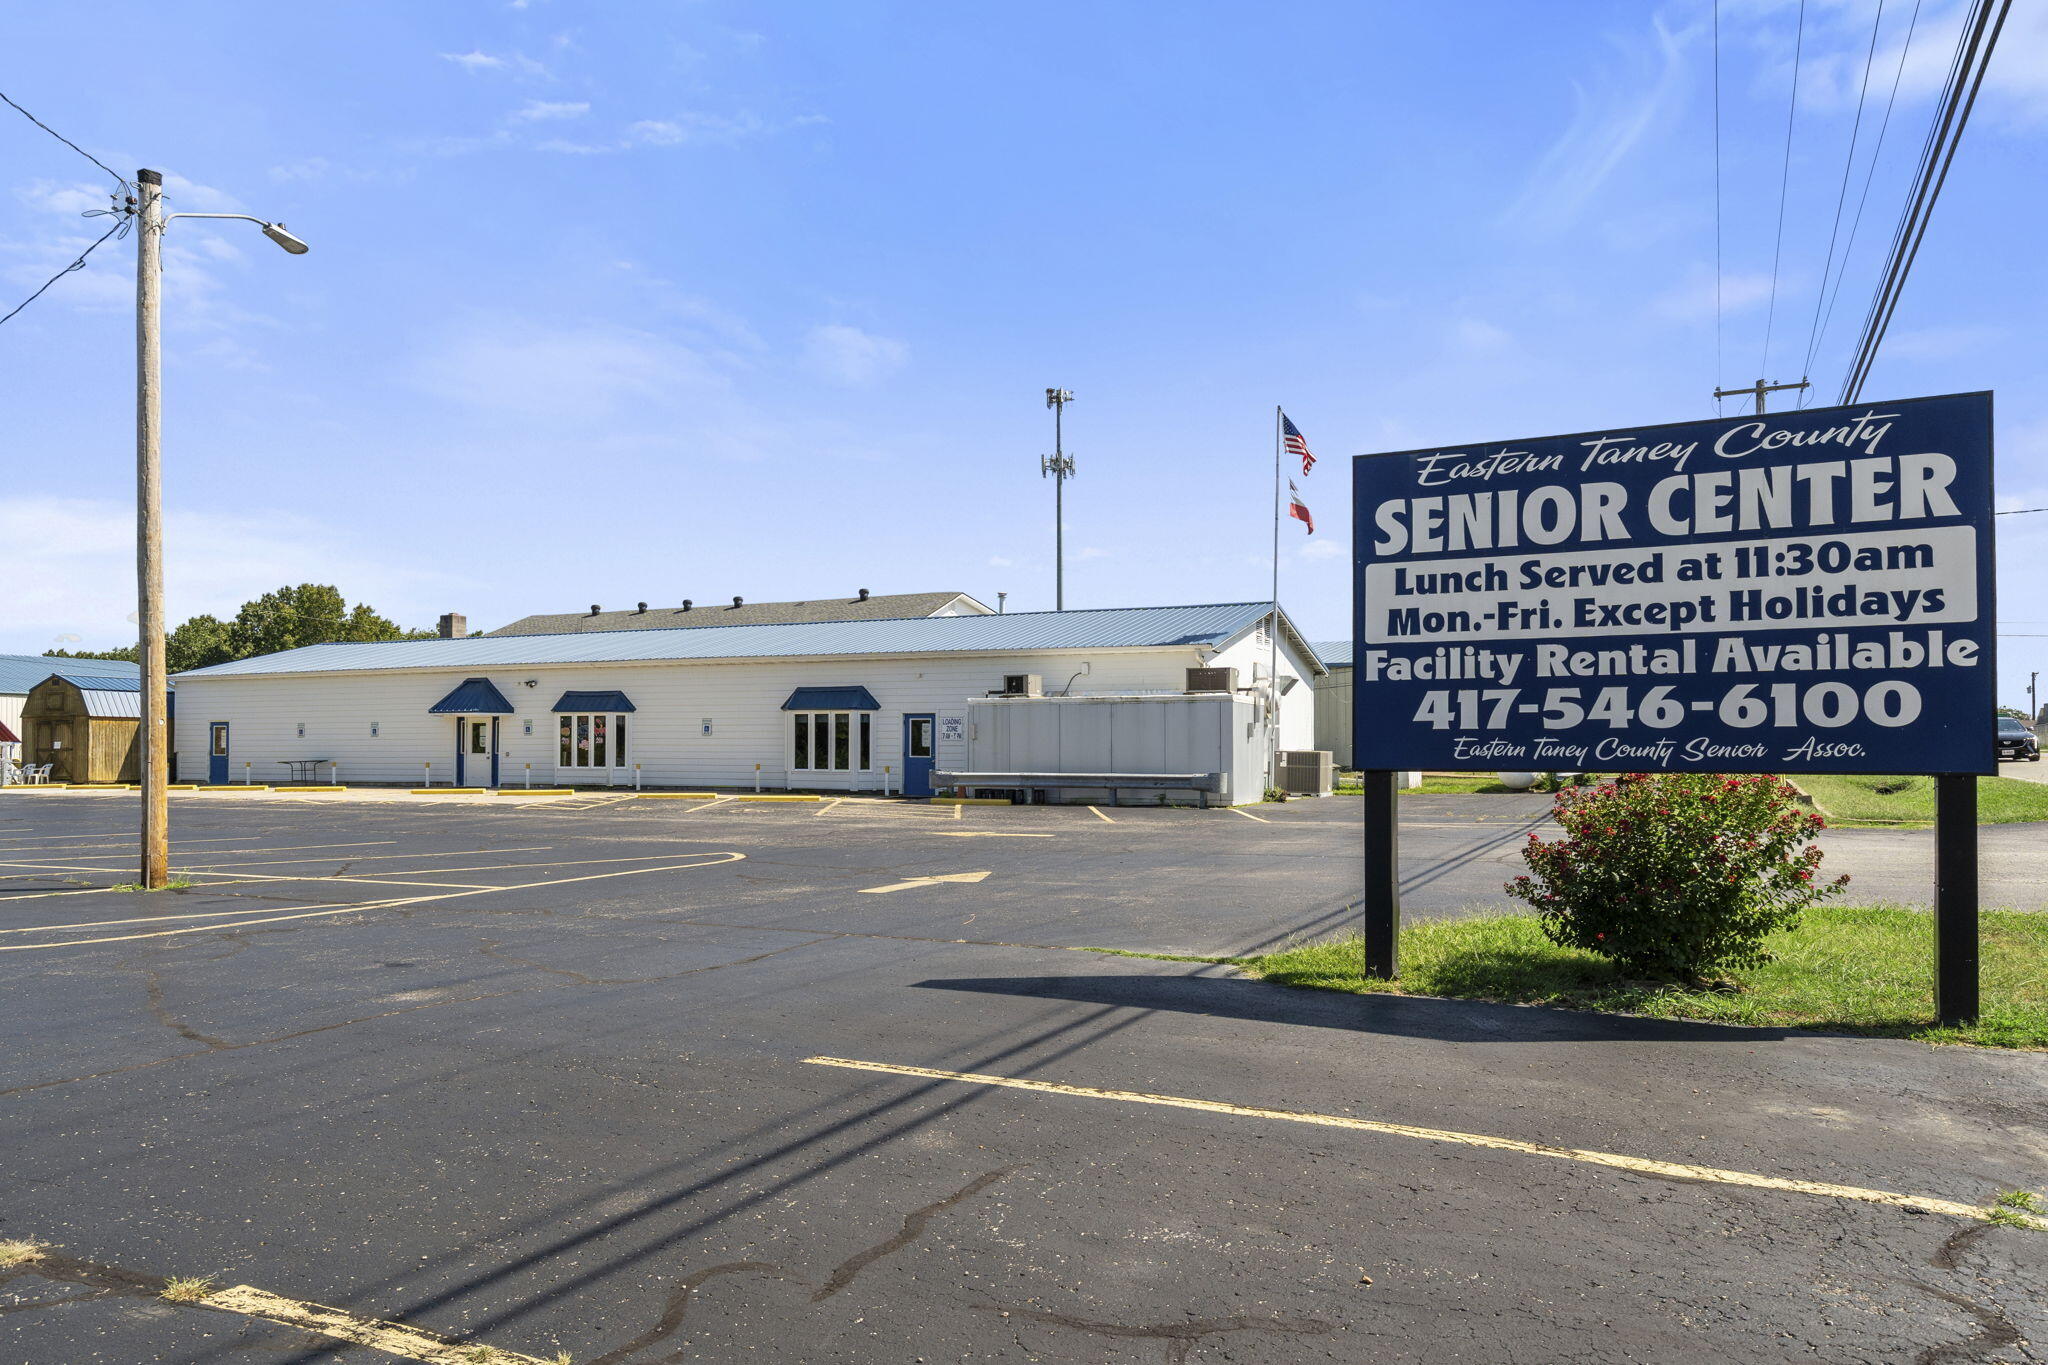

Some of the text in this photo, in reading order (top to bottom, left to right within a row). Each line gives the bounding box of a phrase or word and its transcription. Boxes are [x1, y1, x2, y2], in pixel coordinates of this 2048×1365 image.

[1417, 410, 1900, 485] Eastern Taney County
[1375, 452, 1962, 555] SENIOR CENTER
[1395, 541, 1934, 595] Lunch Served at 11:30am
[1388, 584, 1945, 636] Mon.-Fri. Except Holidays
[1366, 631, 1979, 685] Facility Rental Available
[1413, 681, 1921, 729] 417-546-6100
[1454, 736, 1865, 767] Eastern Taney County Senior Assoc.
